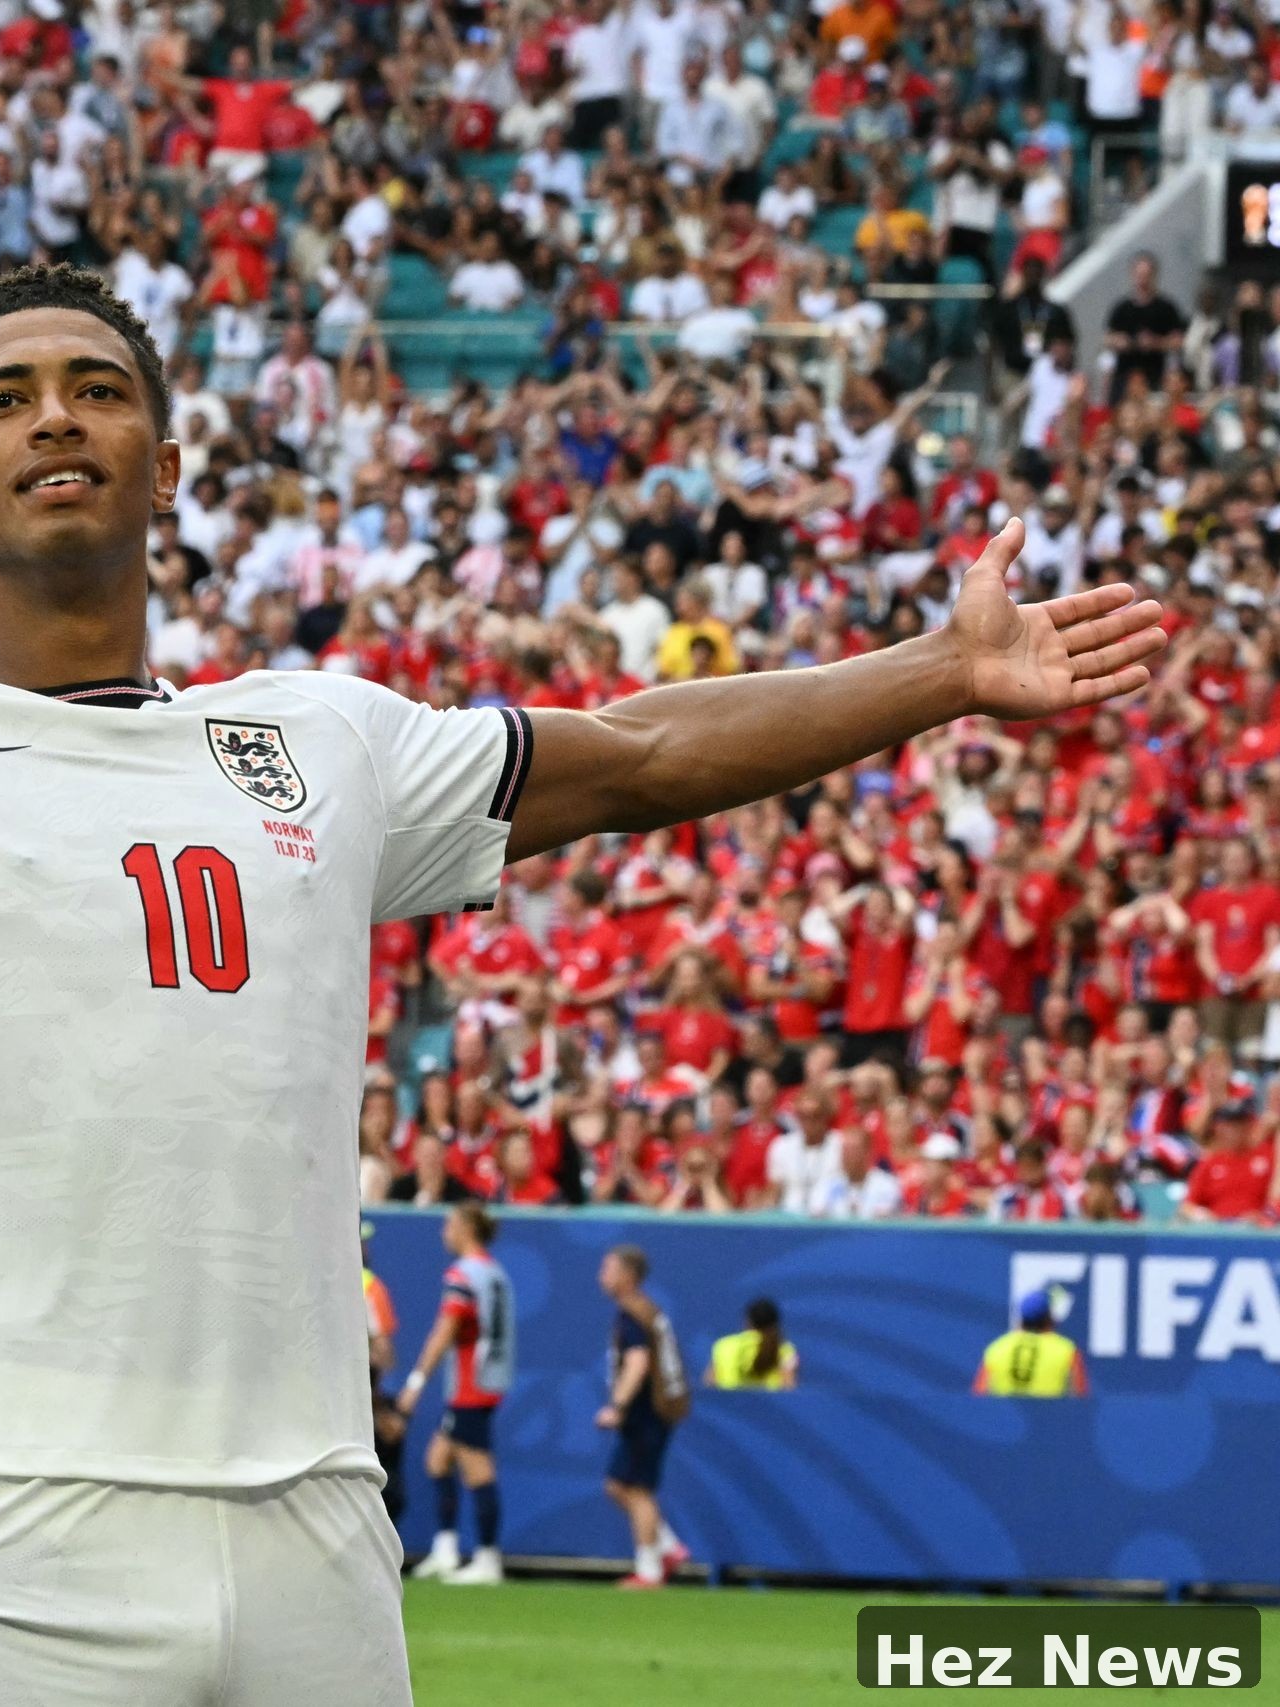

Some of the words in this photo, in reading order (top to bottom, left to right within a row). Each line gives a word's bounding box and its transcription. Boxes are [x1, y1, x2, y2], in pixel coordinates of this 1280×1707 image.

[262, 820, 315, 842] NORWAY
[121, 843, 250, 993] 10
[1009, 1251, 1280, 1362] FIFA
